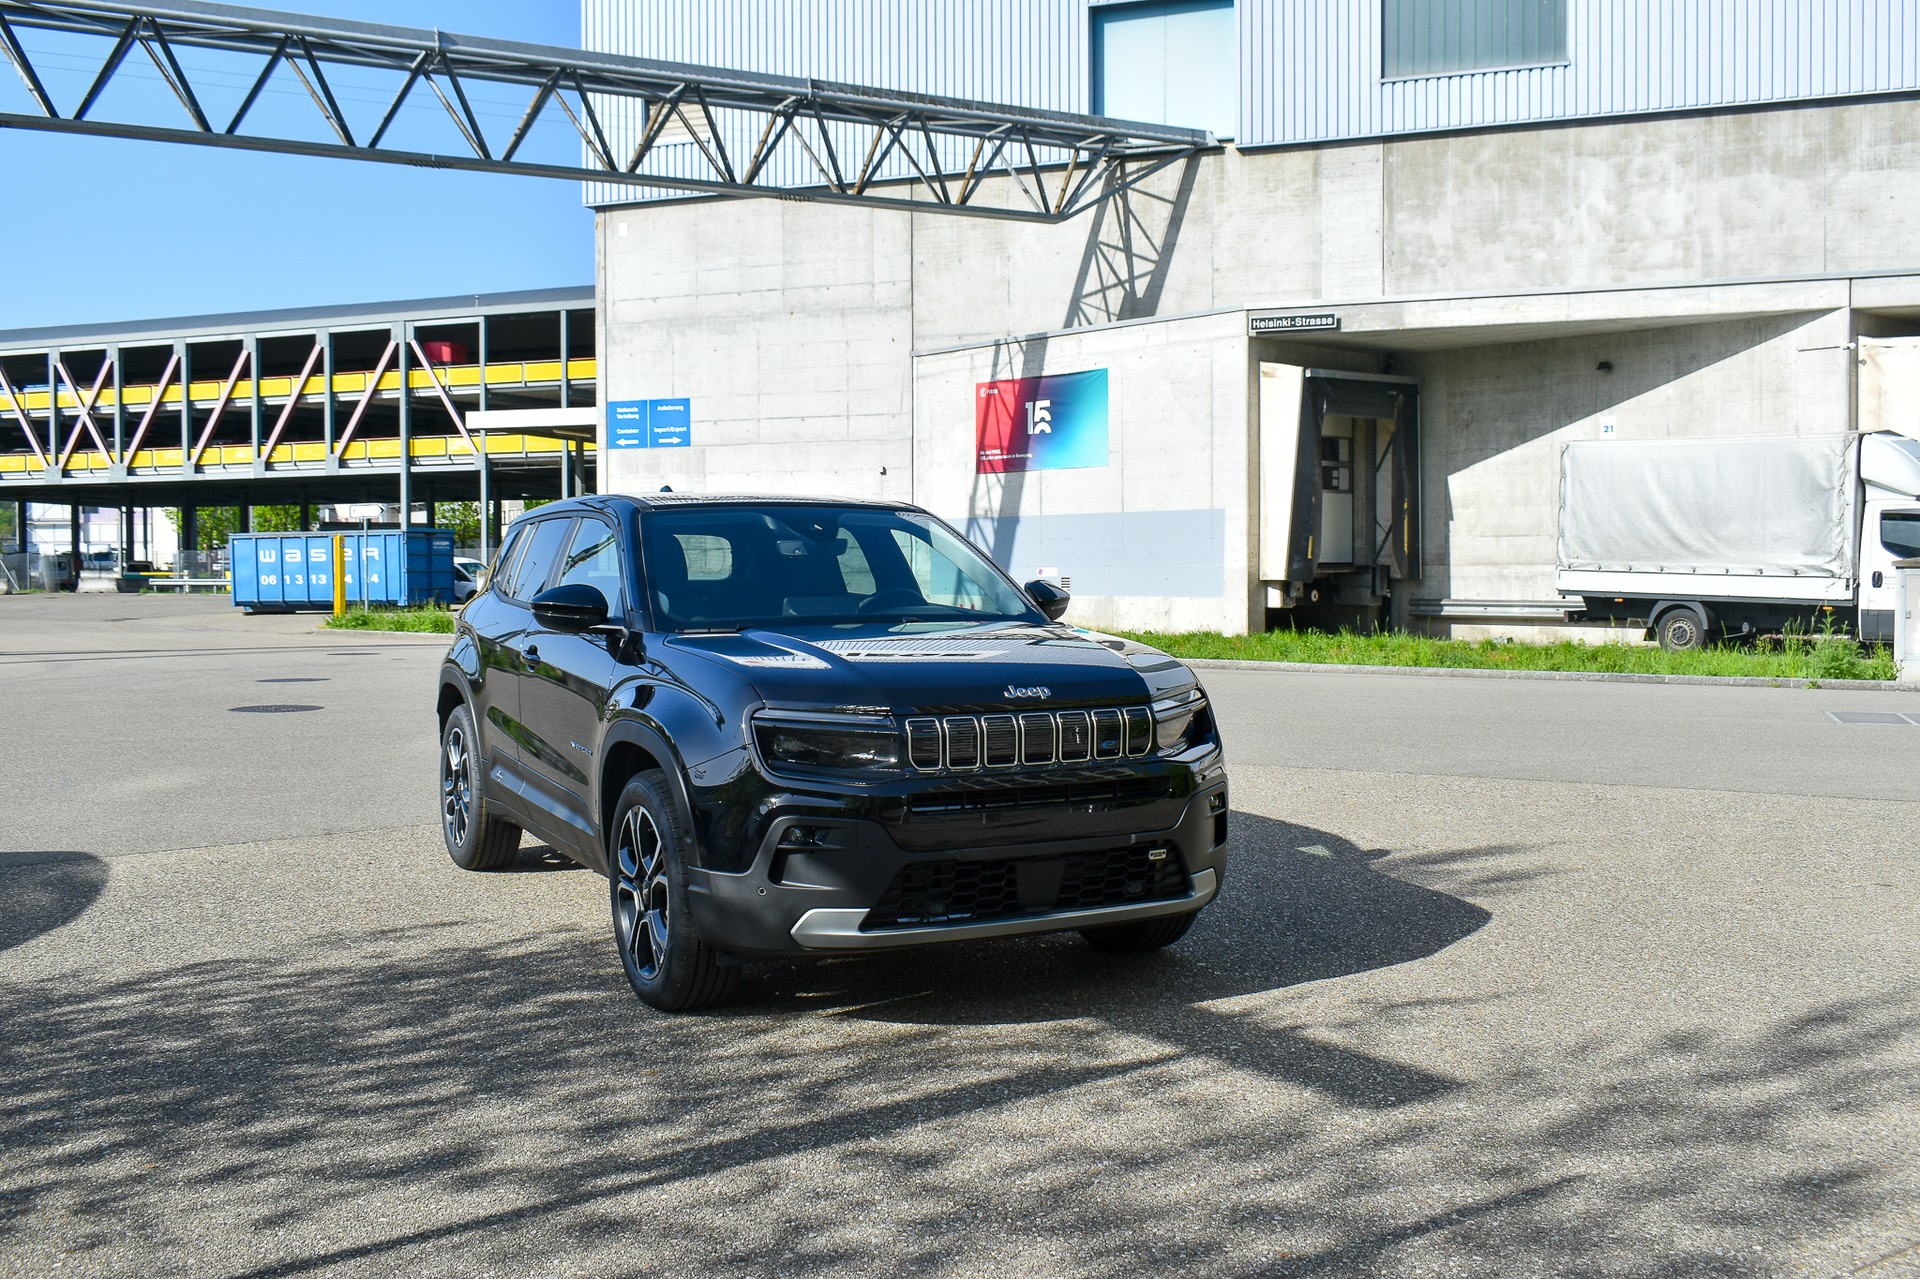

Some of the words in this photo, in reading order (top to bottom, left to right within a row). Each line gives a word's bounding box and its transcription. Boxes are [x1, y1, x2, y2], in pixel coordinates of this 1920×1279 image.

[1252, 317, 1333, 329] Helsinki-Strasse
[1603, 425, 1614, 433] 21
[1004, 685, 1051, 700] Jeep
